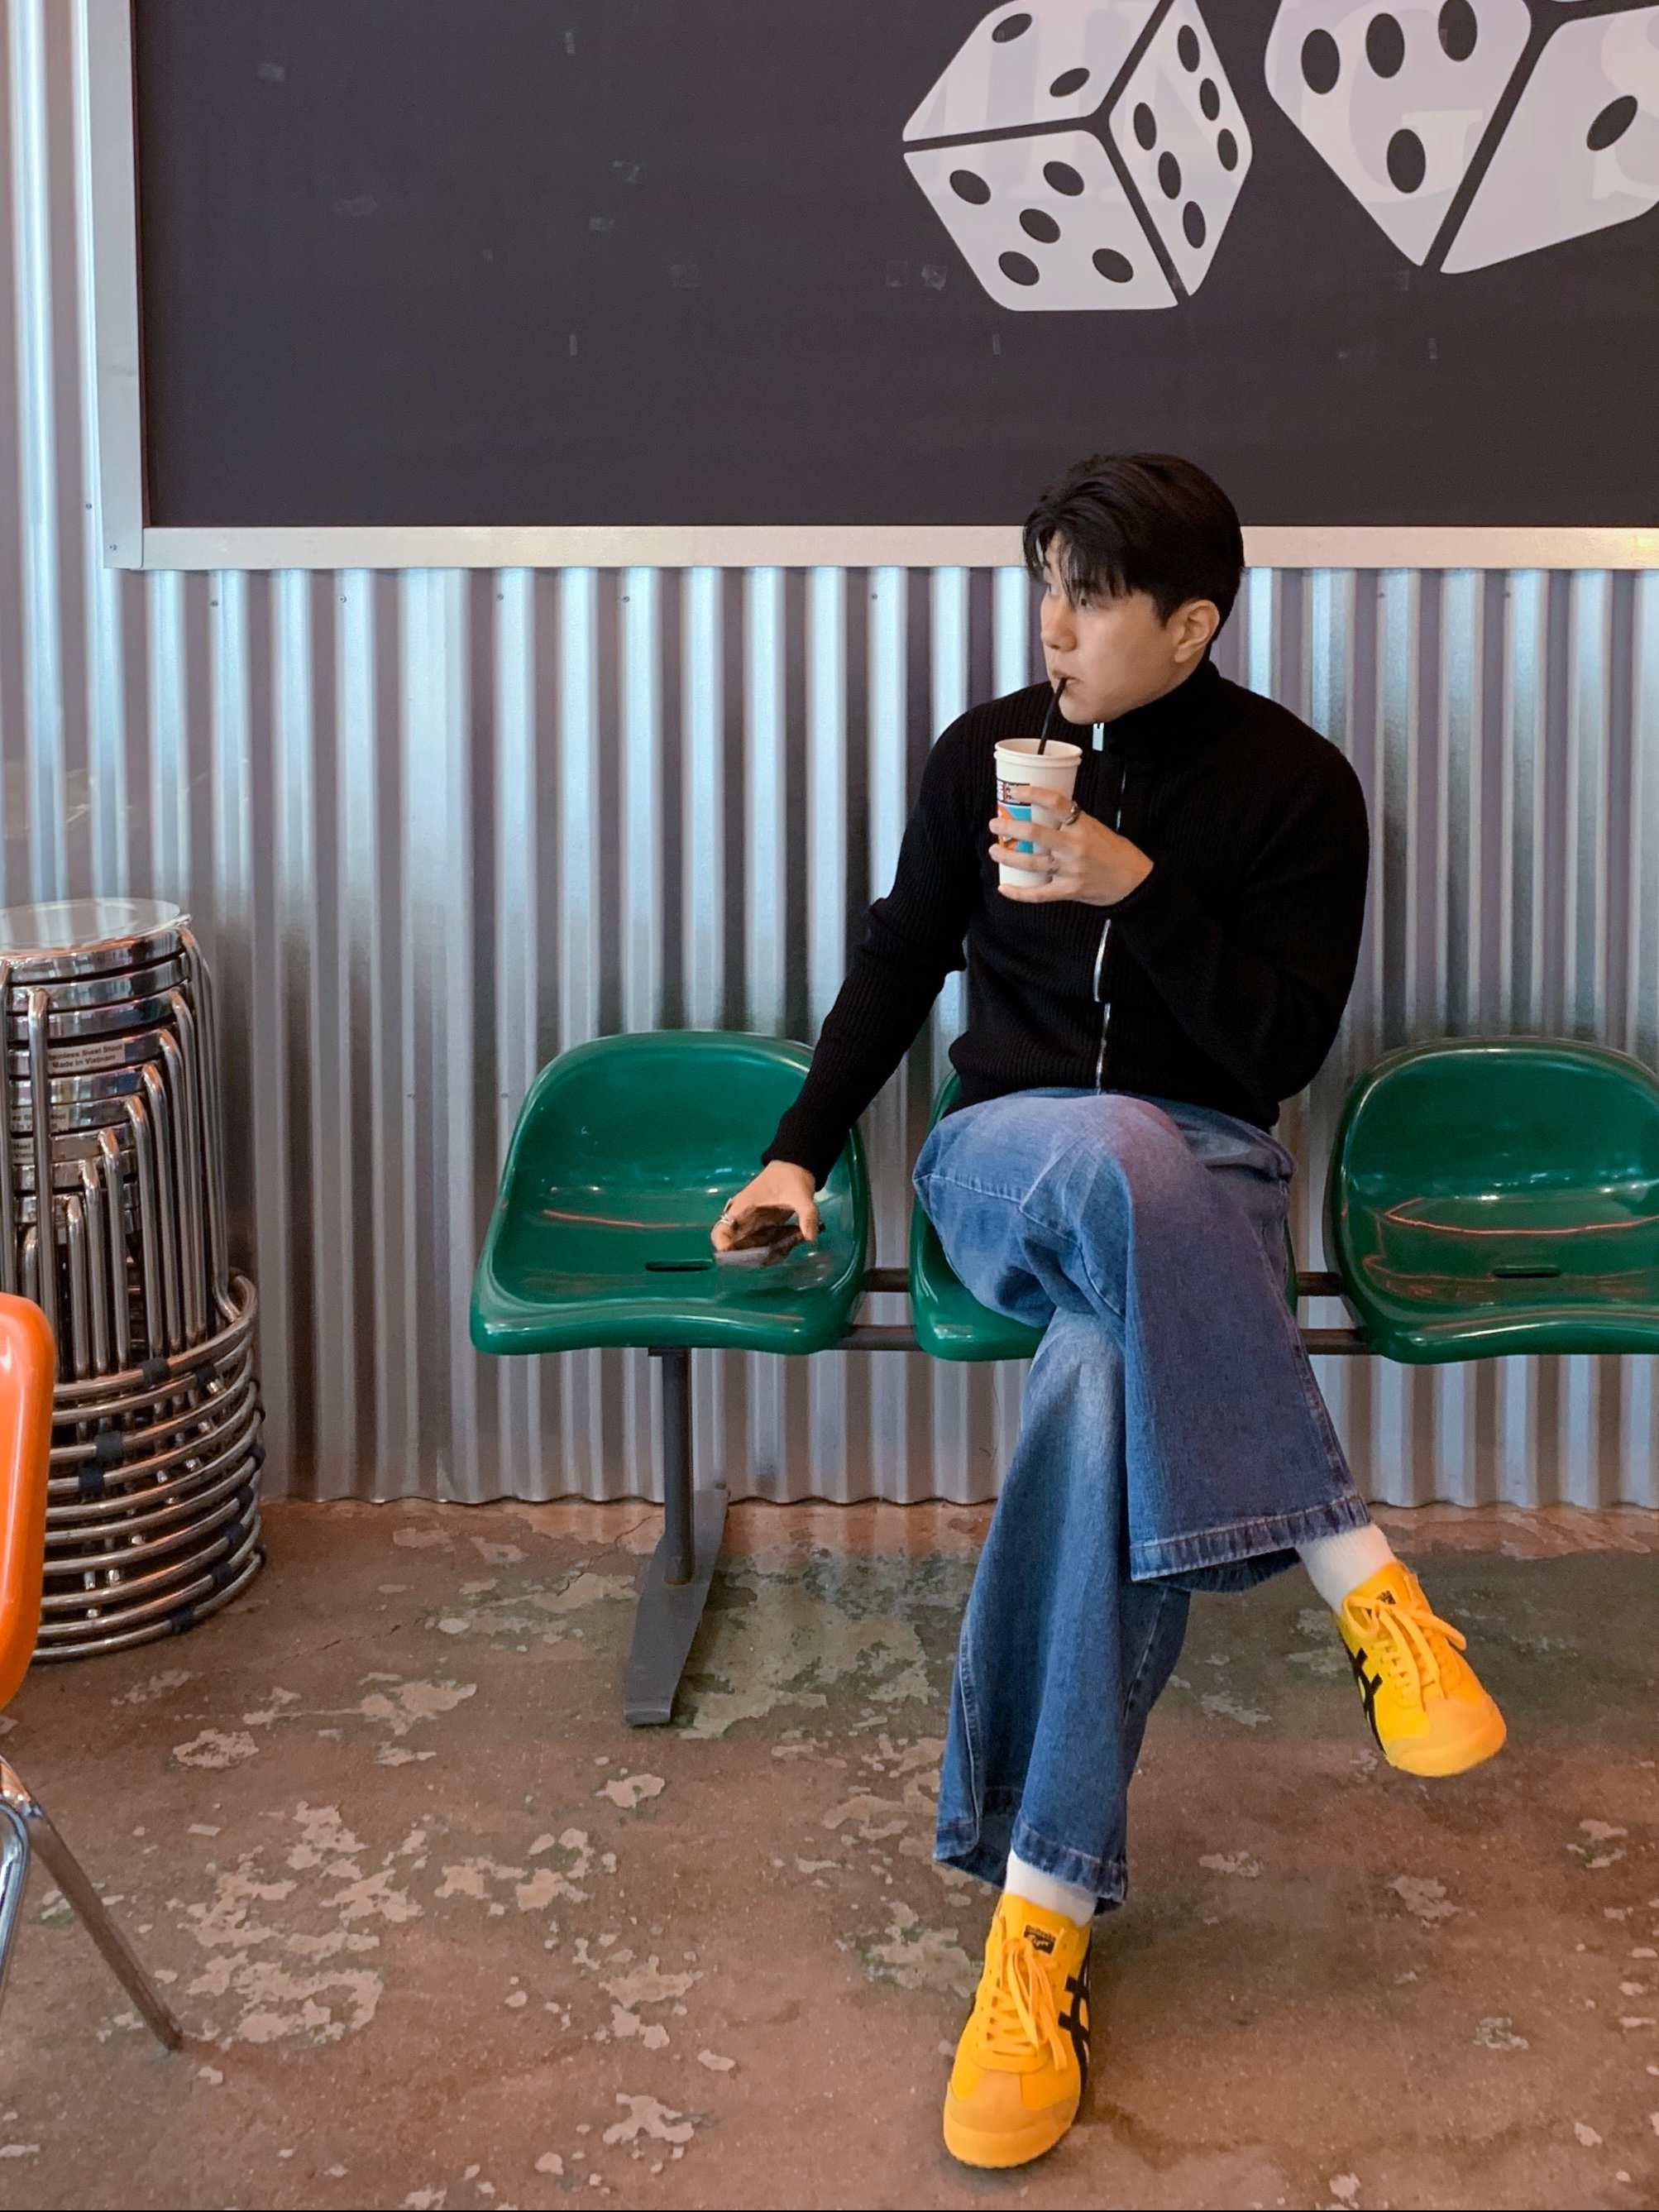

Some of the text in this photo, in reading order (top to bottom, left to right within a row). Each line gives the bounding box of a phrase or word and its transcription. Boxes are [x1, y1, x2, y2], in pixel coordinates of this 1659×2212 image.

[82, 1047, 101, 1056] Steel
[103, 1044, 122, 1053] Stool
[85, 1055, 116, 1065] Vietnam
